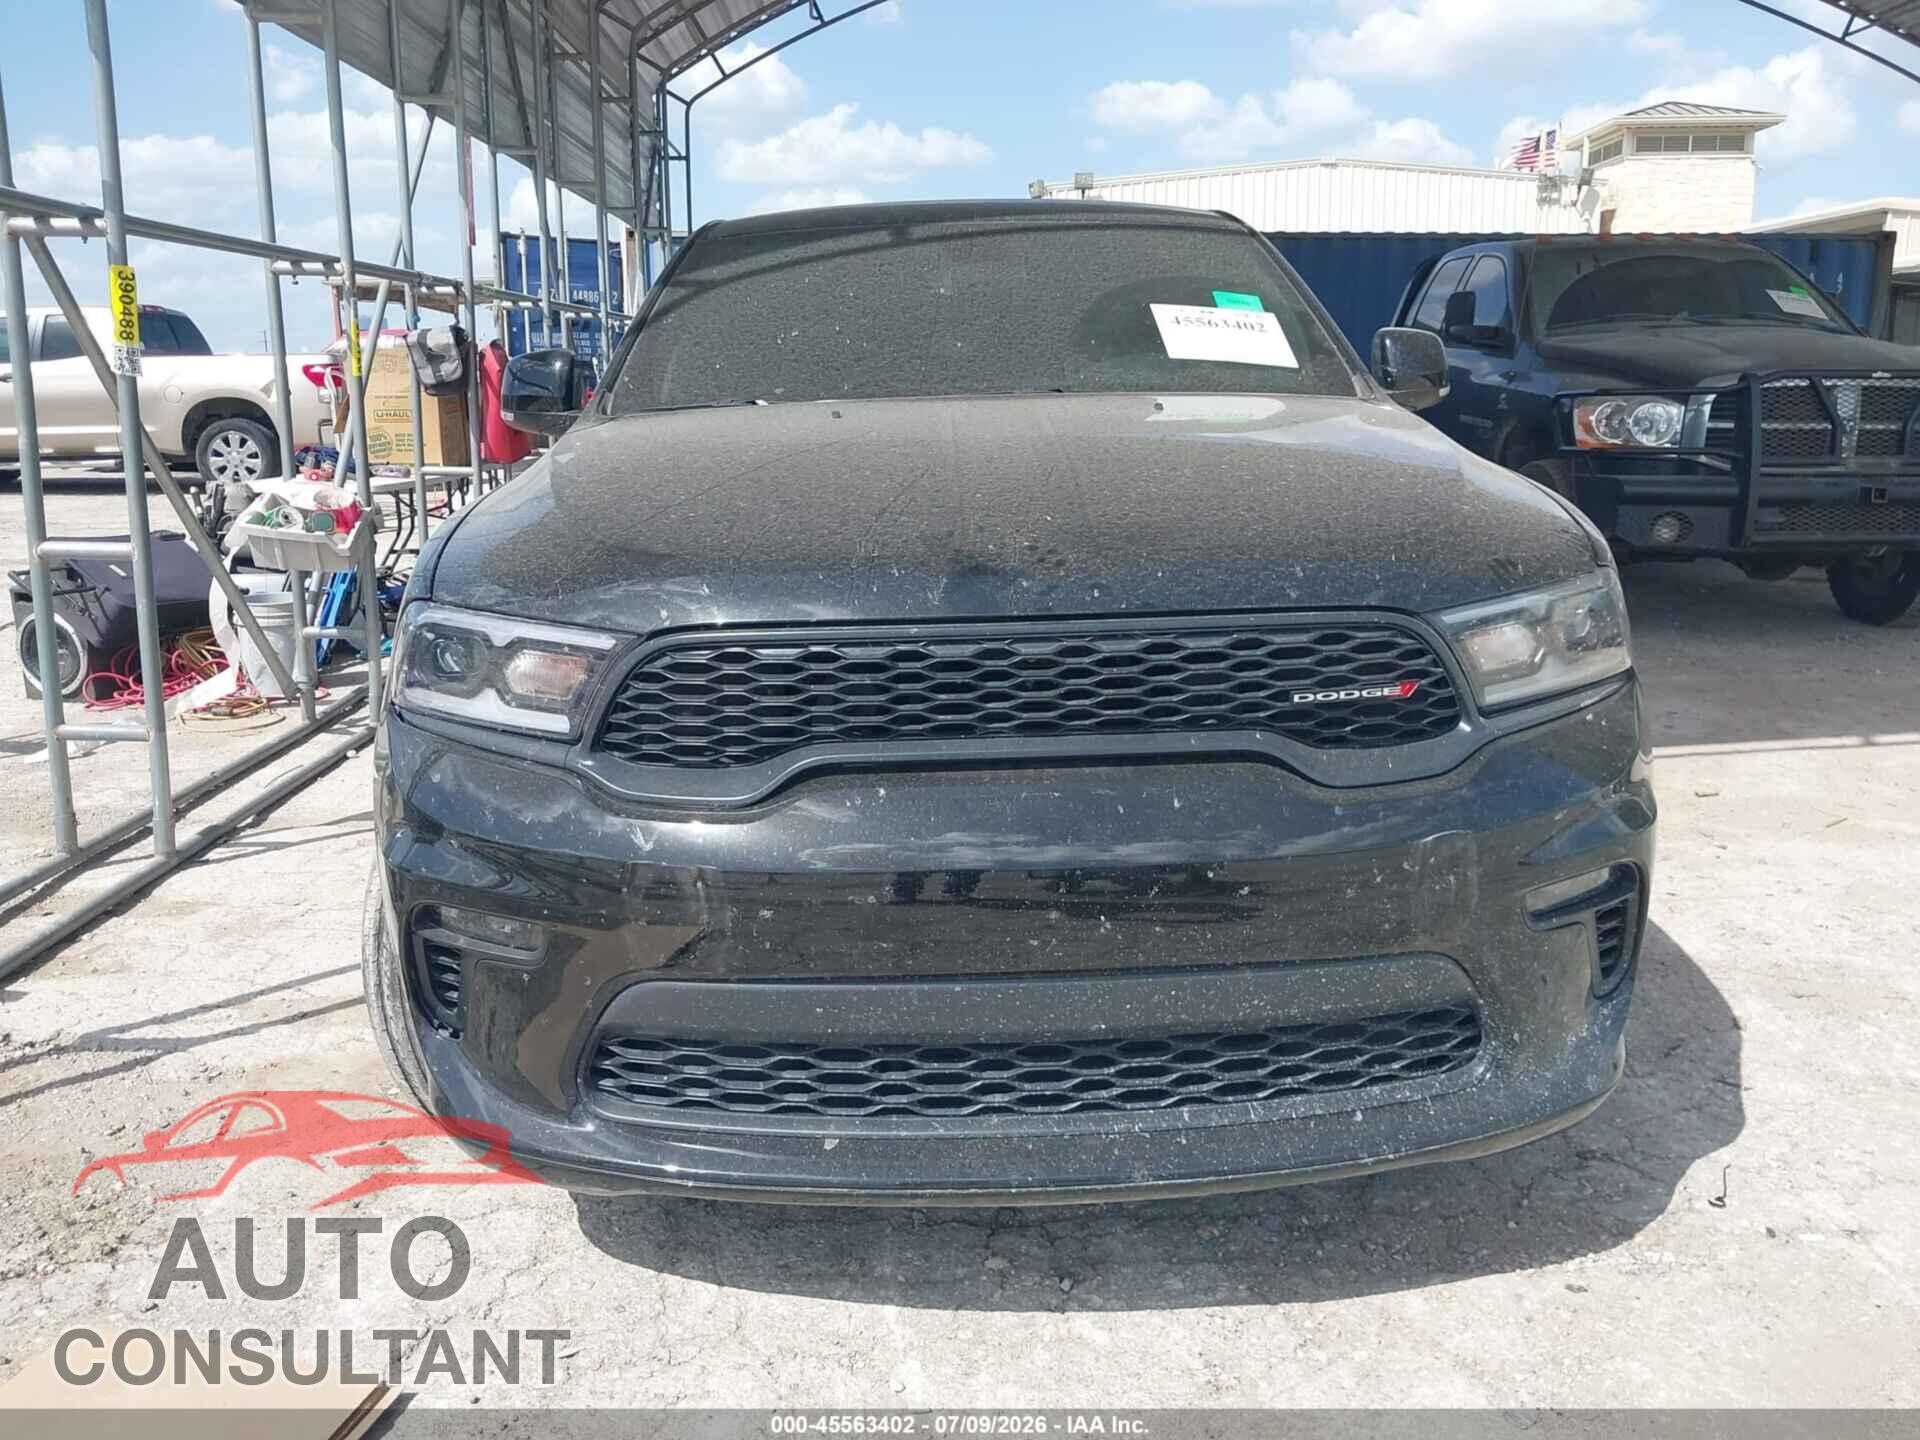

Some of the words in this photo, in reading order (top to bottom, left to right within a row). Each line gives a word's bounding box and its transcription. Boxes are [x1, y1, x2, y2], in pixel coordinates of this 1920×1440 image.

[118, 270, 136, 341] 390488
[1171, 316, 1268, 332] 45563402
[1293, 686, 1403, 703] DODGE
